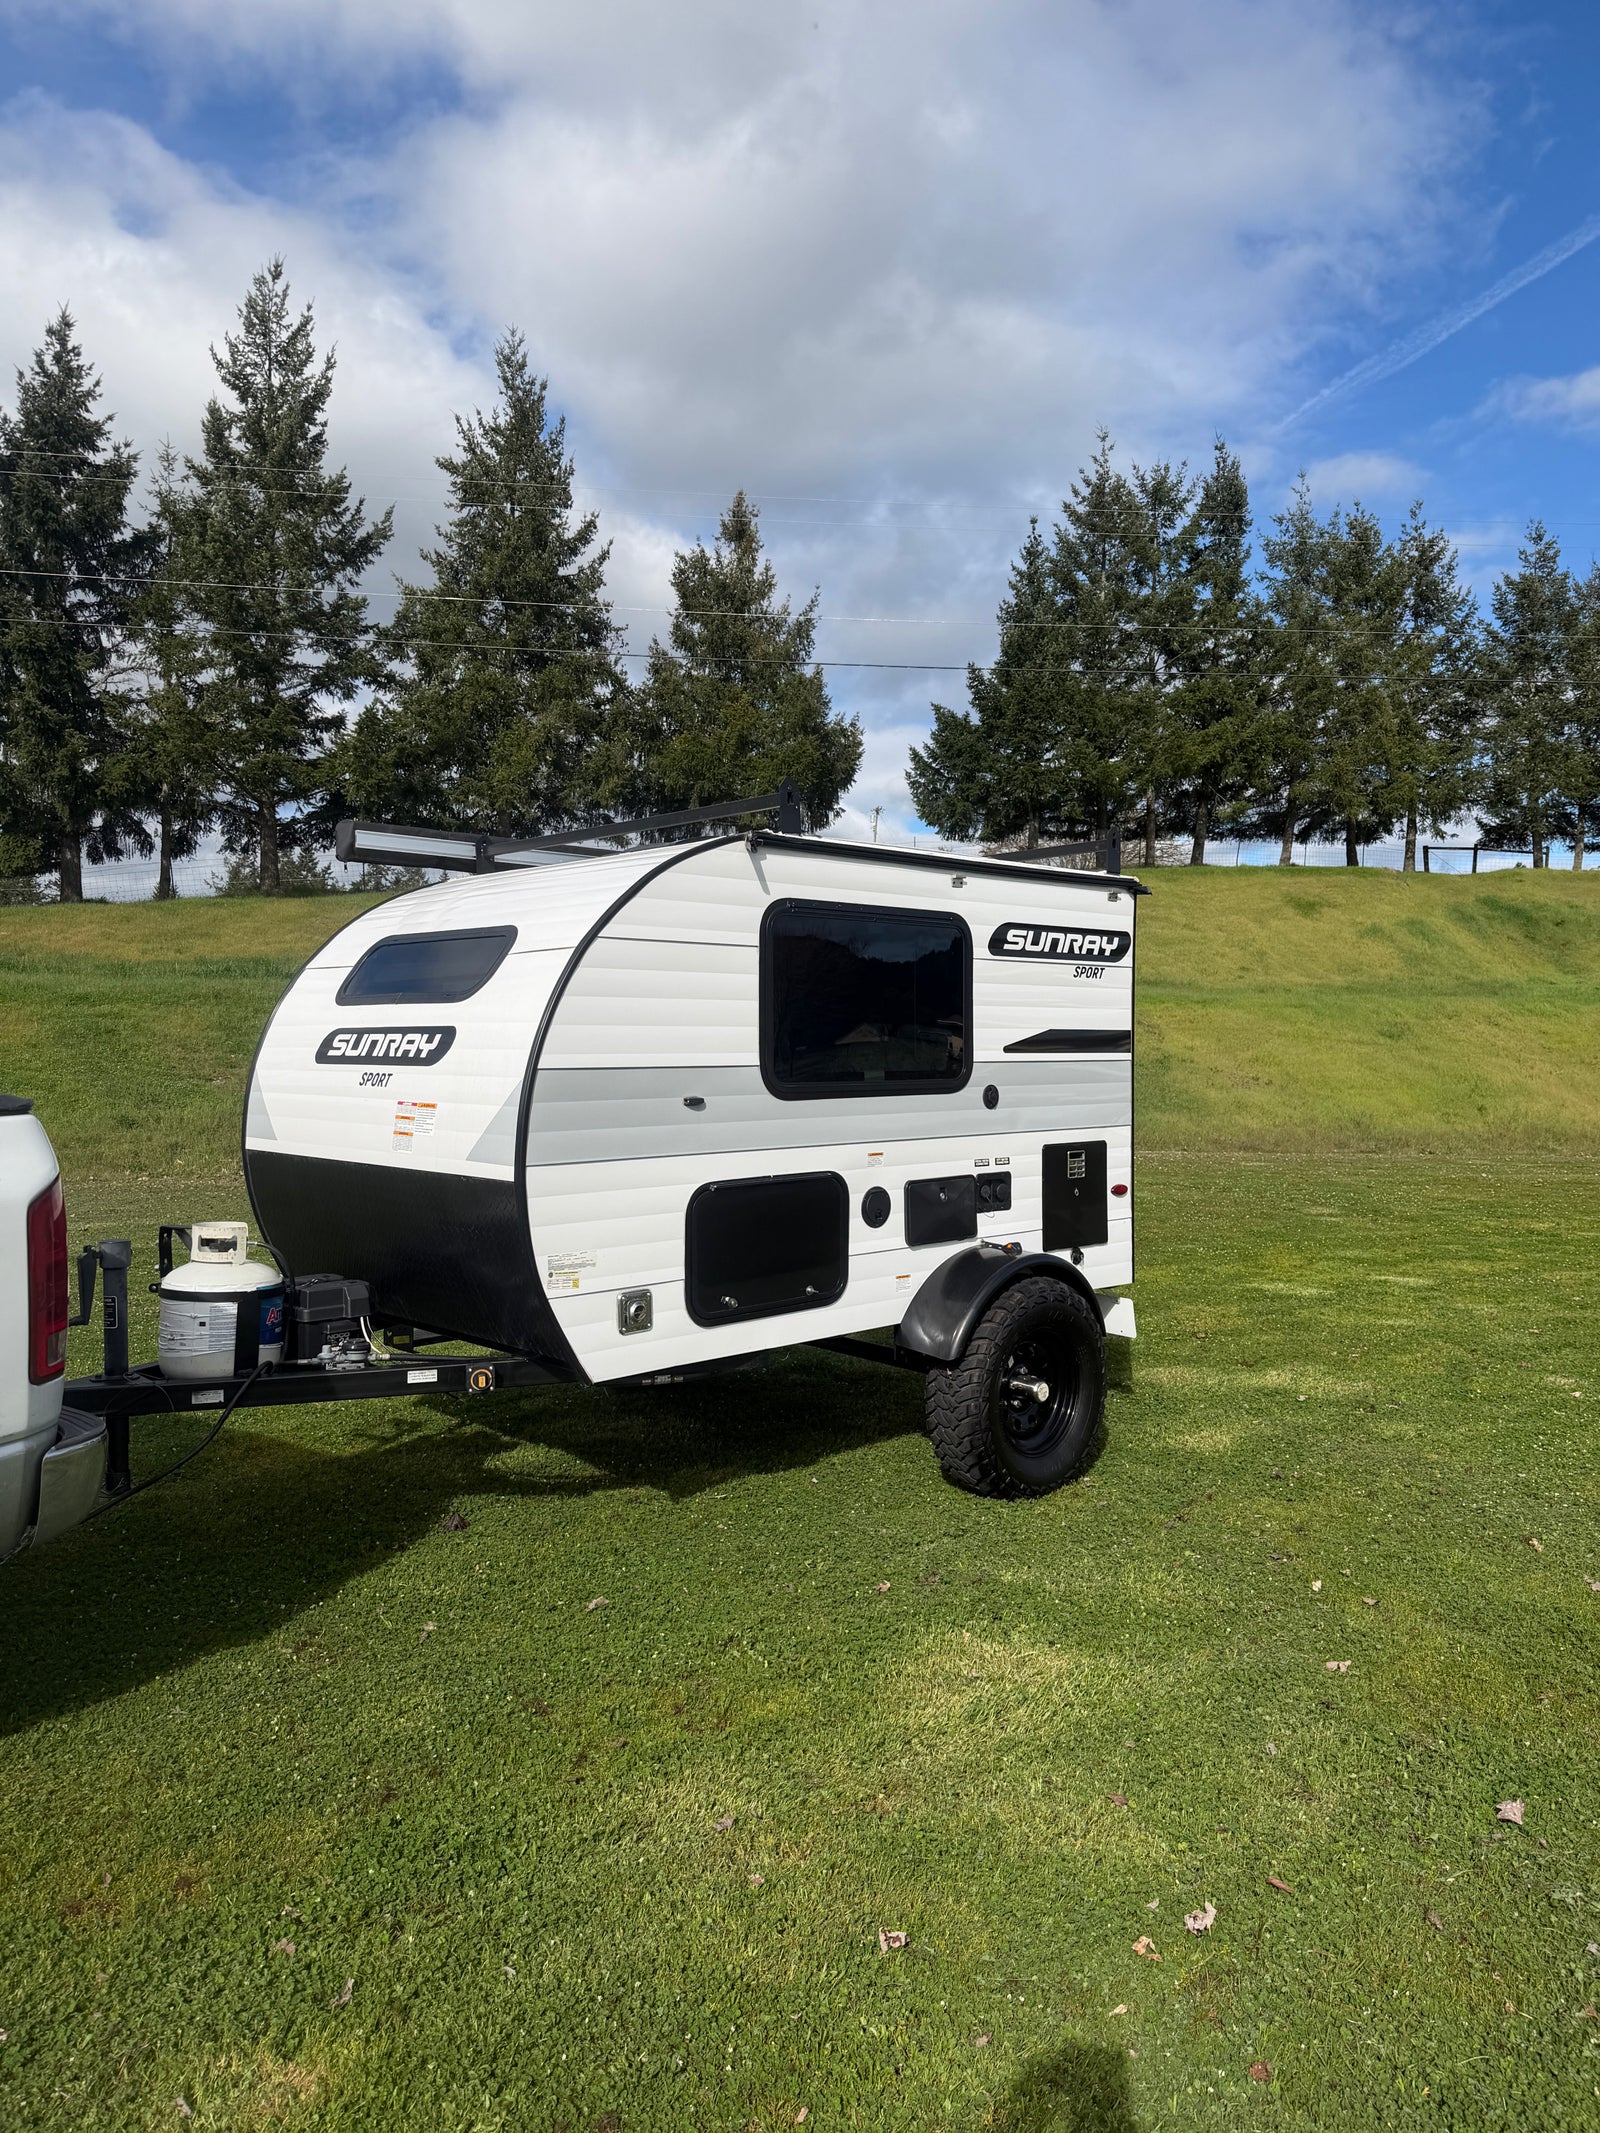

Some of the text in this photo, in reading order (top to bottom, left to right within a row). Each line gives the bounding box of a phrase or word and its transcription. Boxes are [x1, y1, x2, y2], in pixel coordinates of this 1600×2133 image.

[1003, 929, 1120, 956] SUNRAY
[1073, 966, 1105, 980] SPORT
[327, 1033, 442, 1058] SUNRAY
[359, 1072, 393, 1088] SPORT
